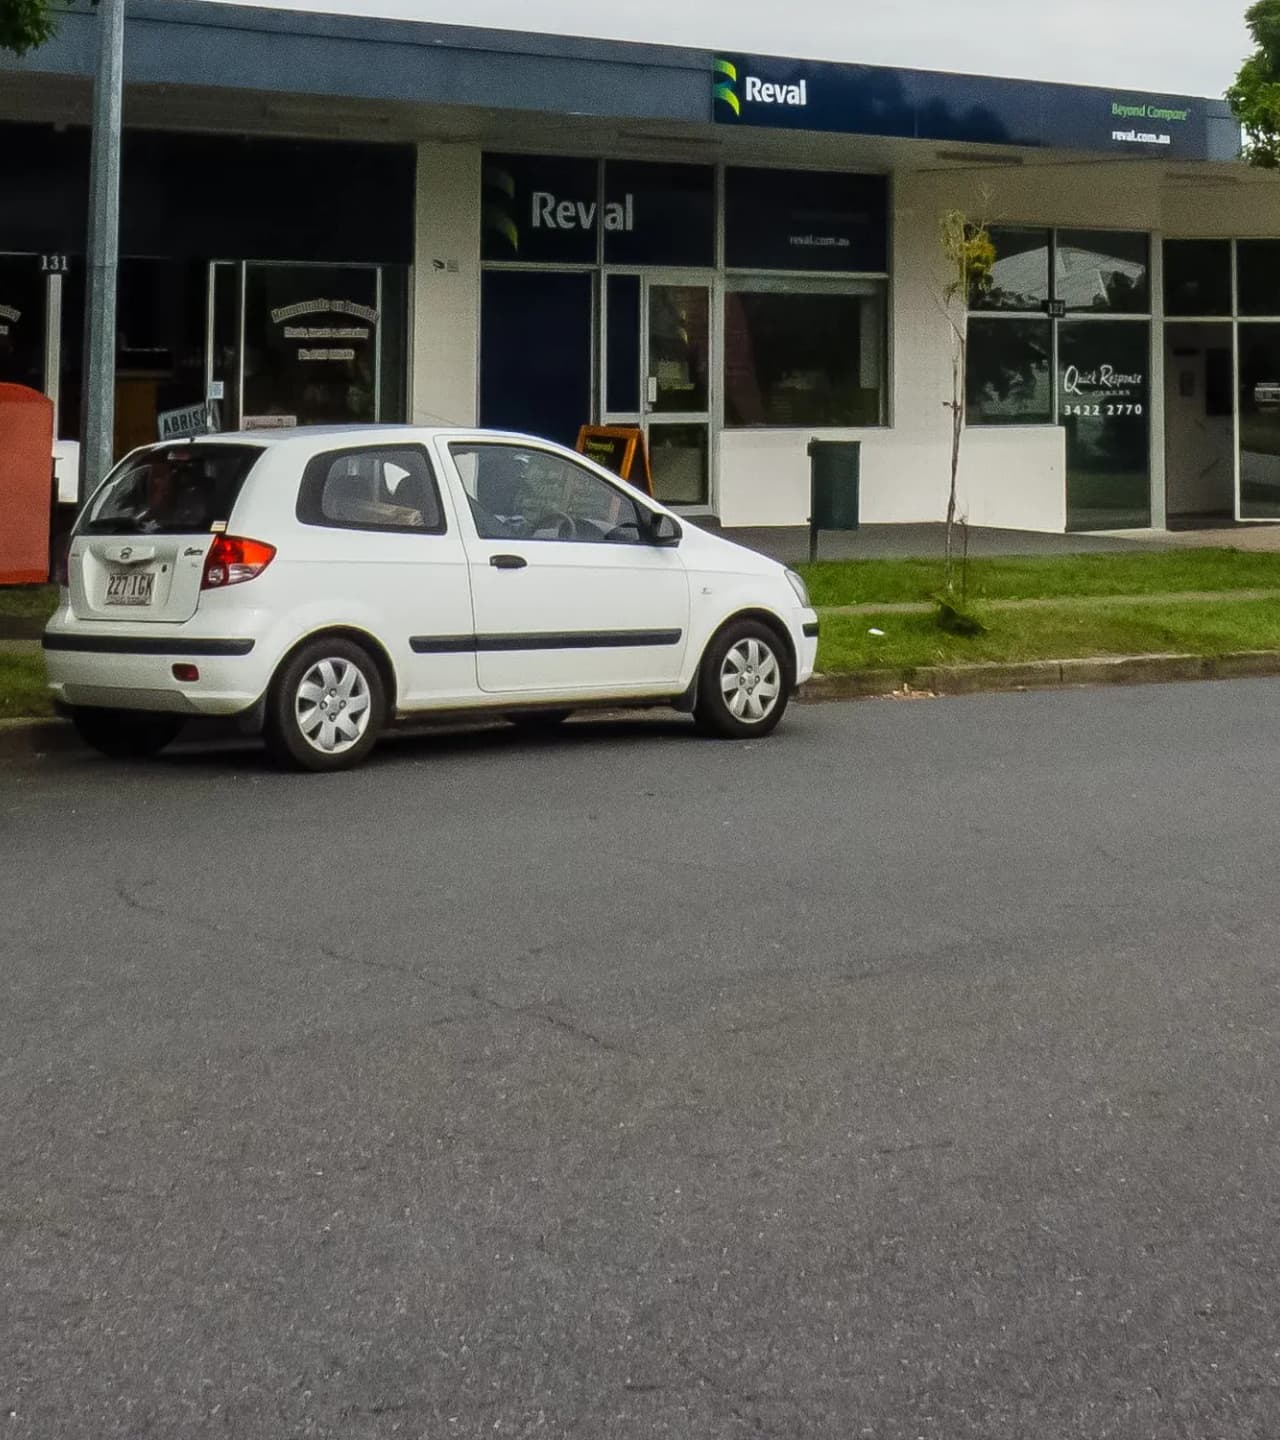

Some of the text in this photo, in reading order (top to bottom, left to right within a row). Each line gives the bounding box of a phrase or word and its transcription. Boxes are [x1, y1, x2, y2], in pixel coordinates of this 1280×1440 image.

[745, 76, 807, 106] Reval
[1111, 102, 1146, 118] Beyond
[1111, 129, 1171, 145] reval.com.au
[531, 191, 633, 231] Reval
[41, 255, 69, 270] 131
[1063, 404, 1142, 416] 3422 2770
[107, 575, 128, 595] 227
